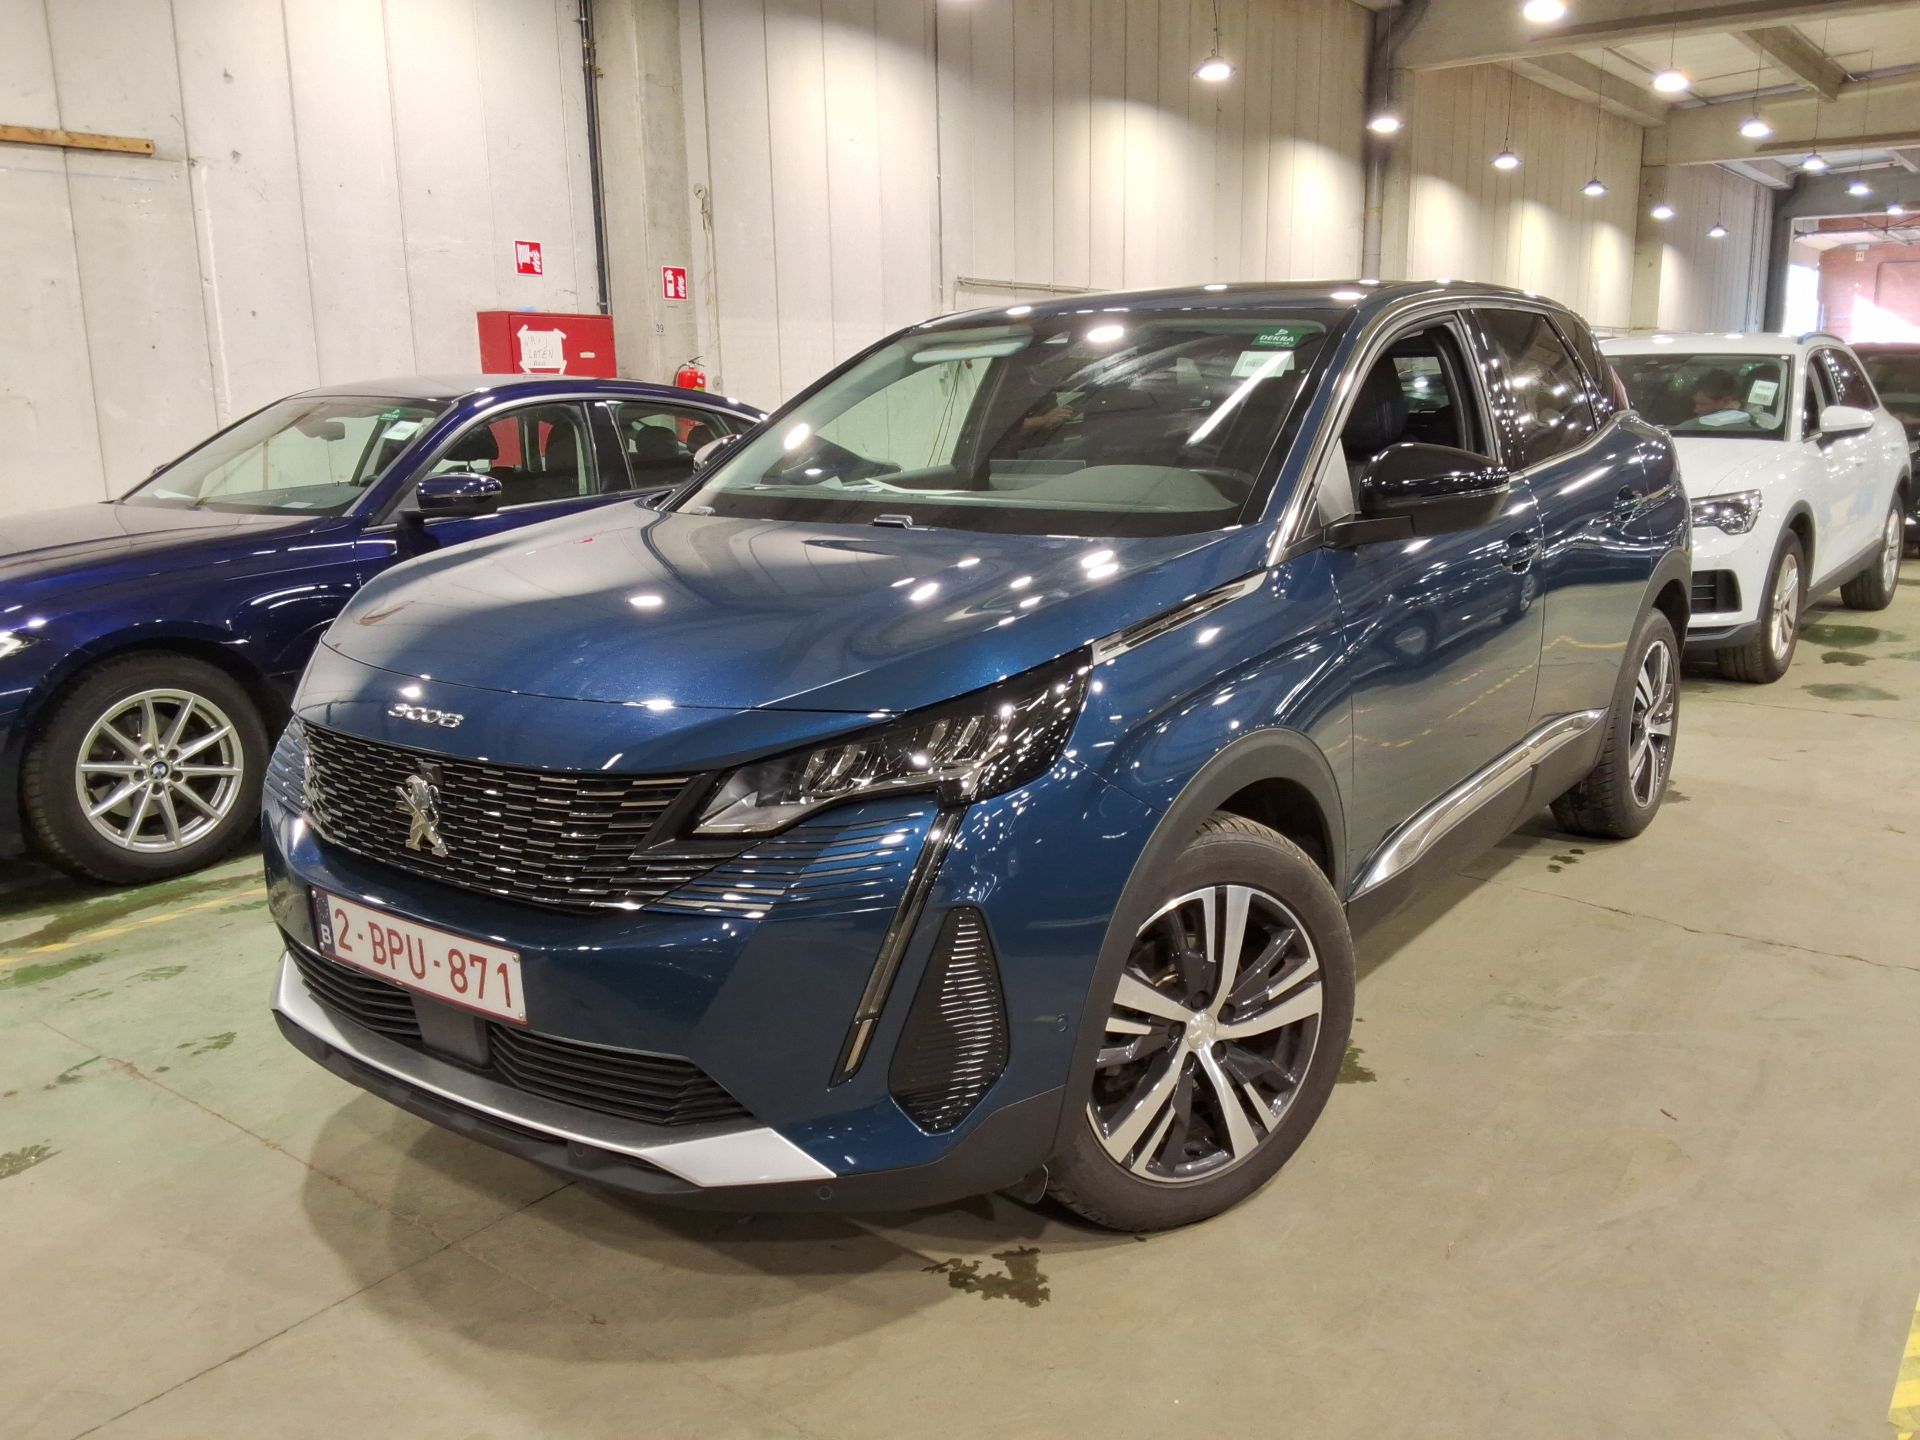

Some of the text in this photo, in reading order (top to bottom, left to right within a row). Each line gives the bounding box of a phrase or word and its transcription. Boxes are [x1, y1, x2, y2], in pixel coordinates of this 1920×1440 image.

[656, 323, 664, 333] 39
[388, 703, 464, 728] 3008
[321, 924, 332, 945] B
[335, 908, 511, 1009] 2-BPU-871
